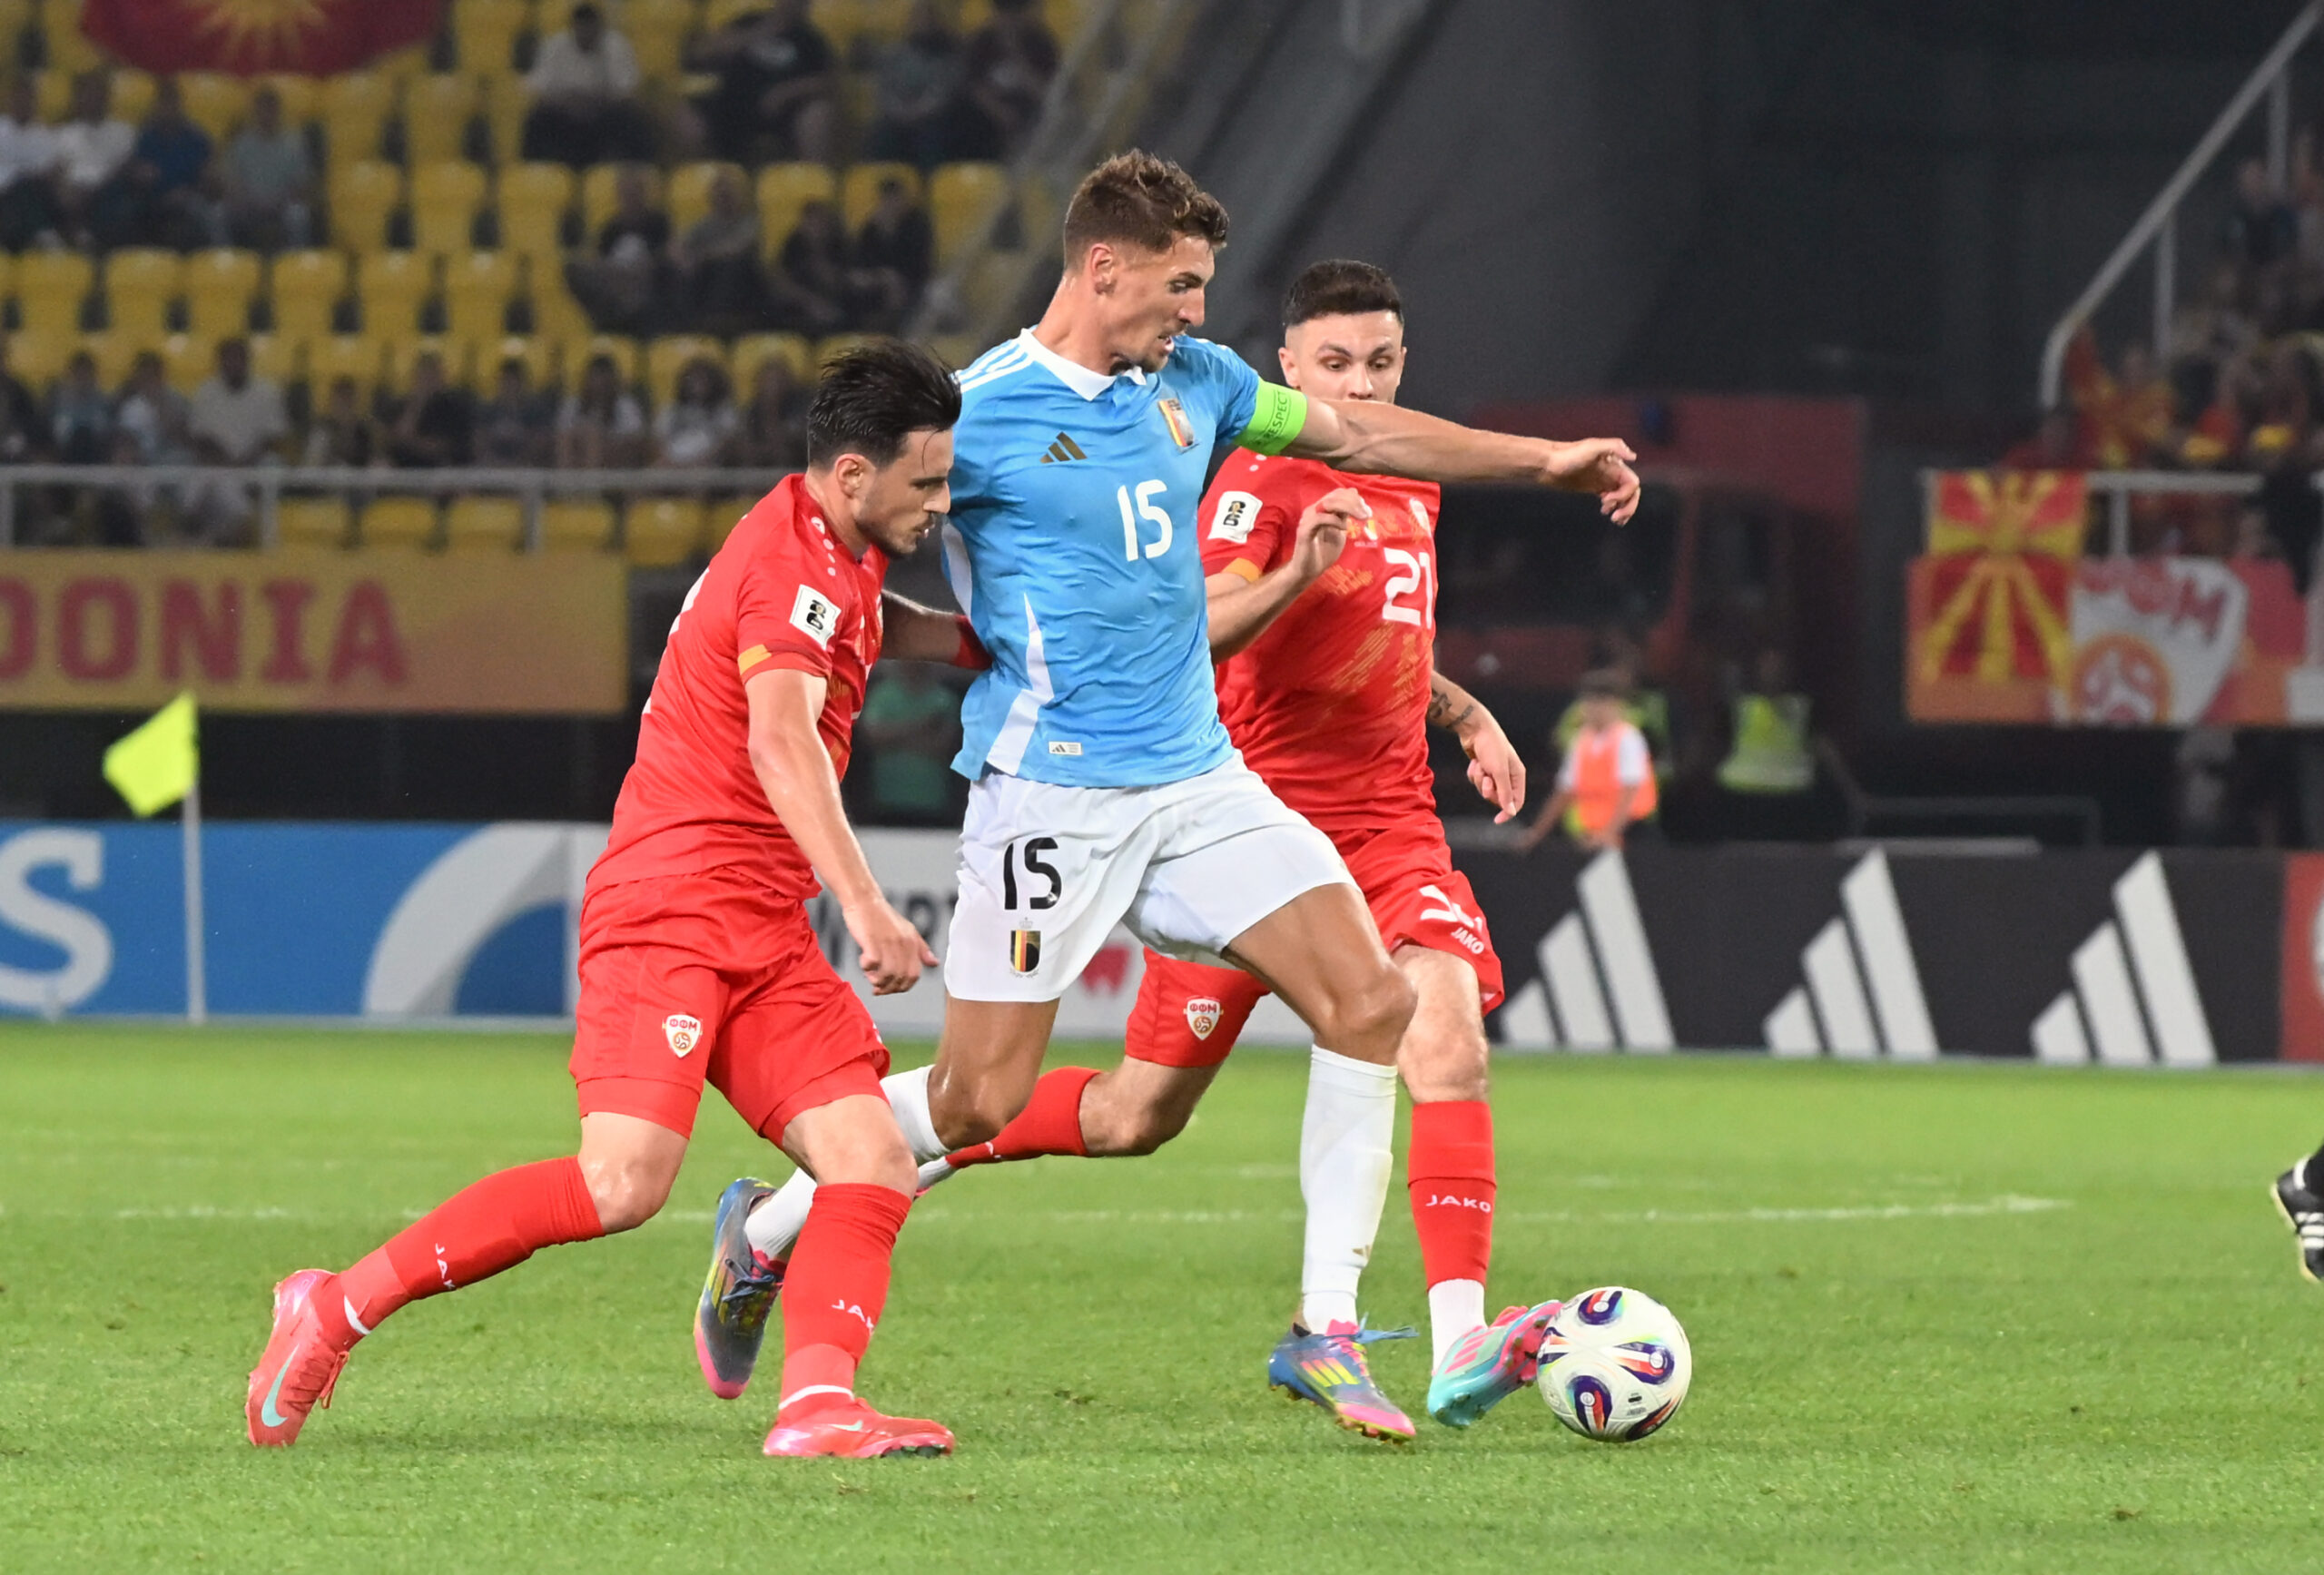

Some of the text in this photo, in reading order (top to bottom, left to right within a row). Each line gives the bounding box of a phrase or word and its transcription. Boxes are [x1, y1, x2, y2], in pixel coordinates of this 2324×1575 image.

[1117, 479, 1173, 562] 15
[1382, 547, 1433, 630] 21
[1003, 837, 1062, 911] 15
[1451, 927, 1484, 954] JAKO
[1425, 1194, 1492, 1213] JAKO
